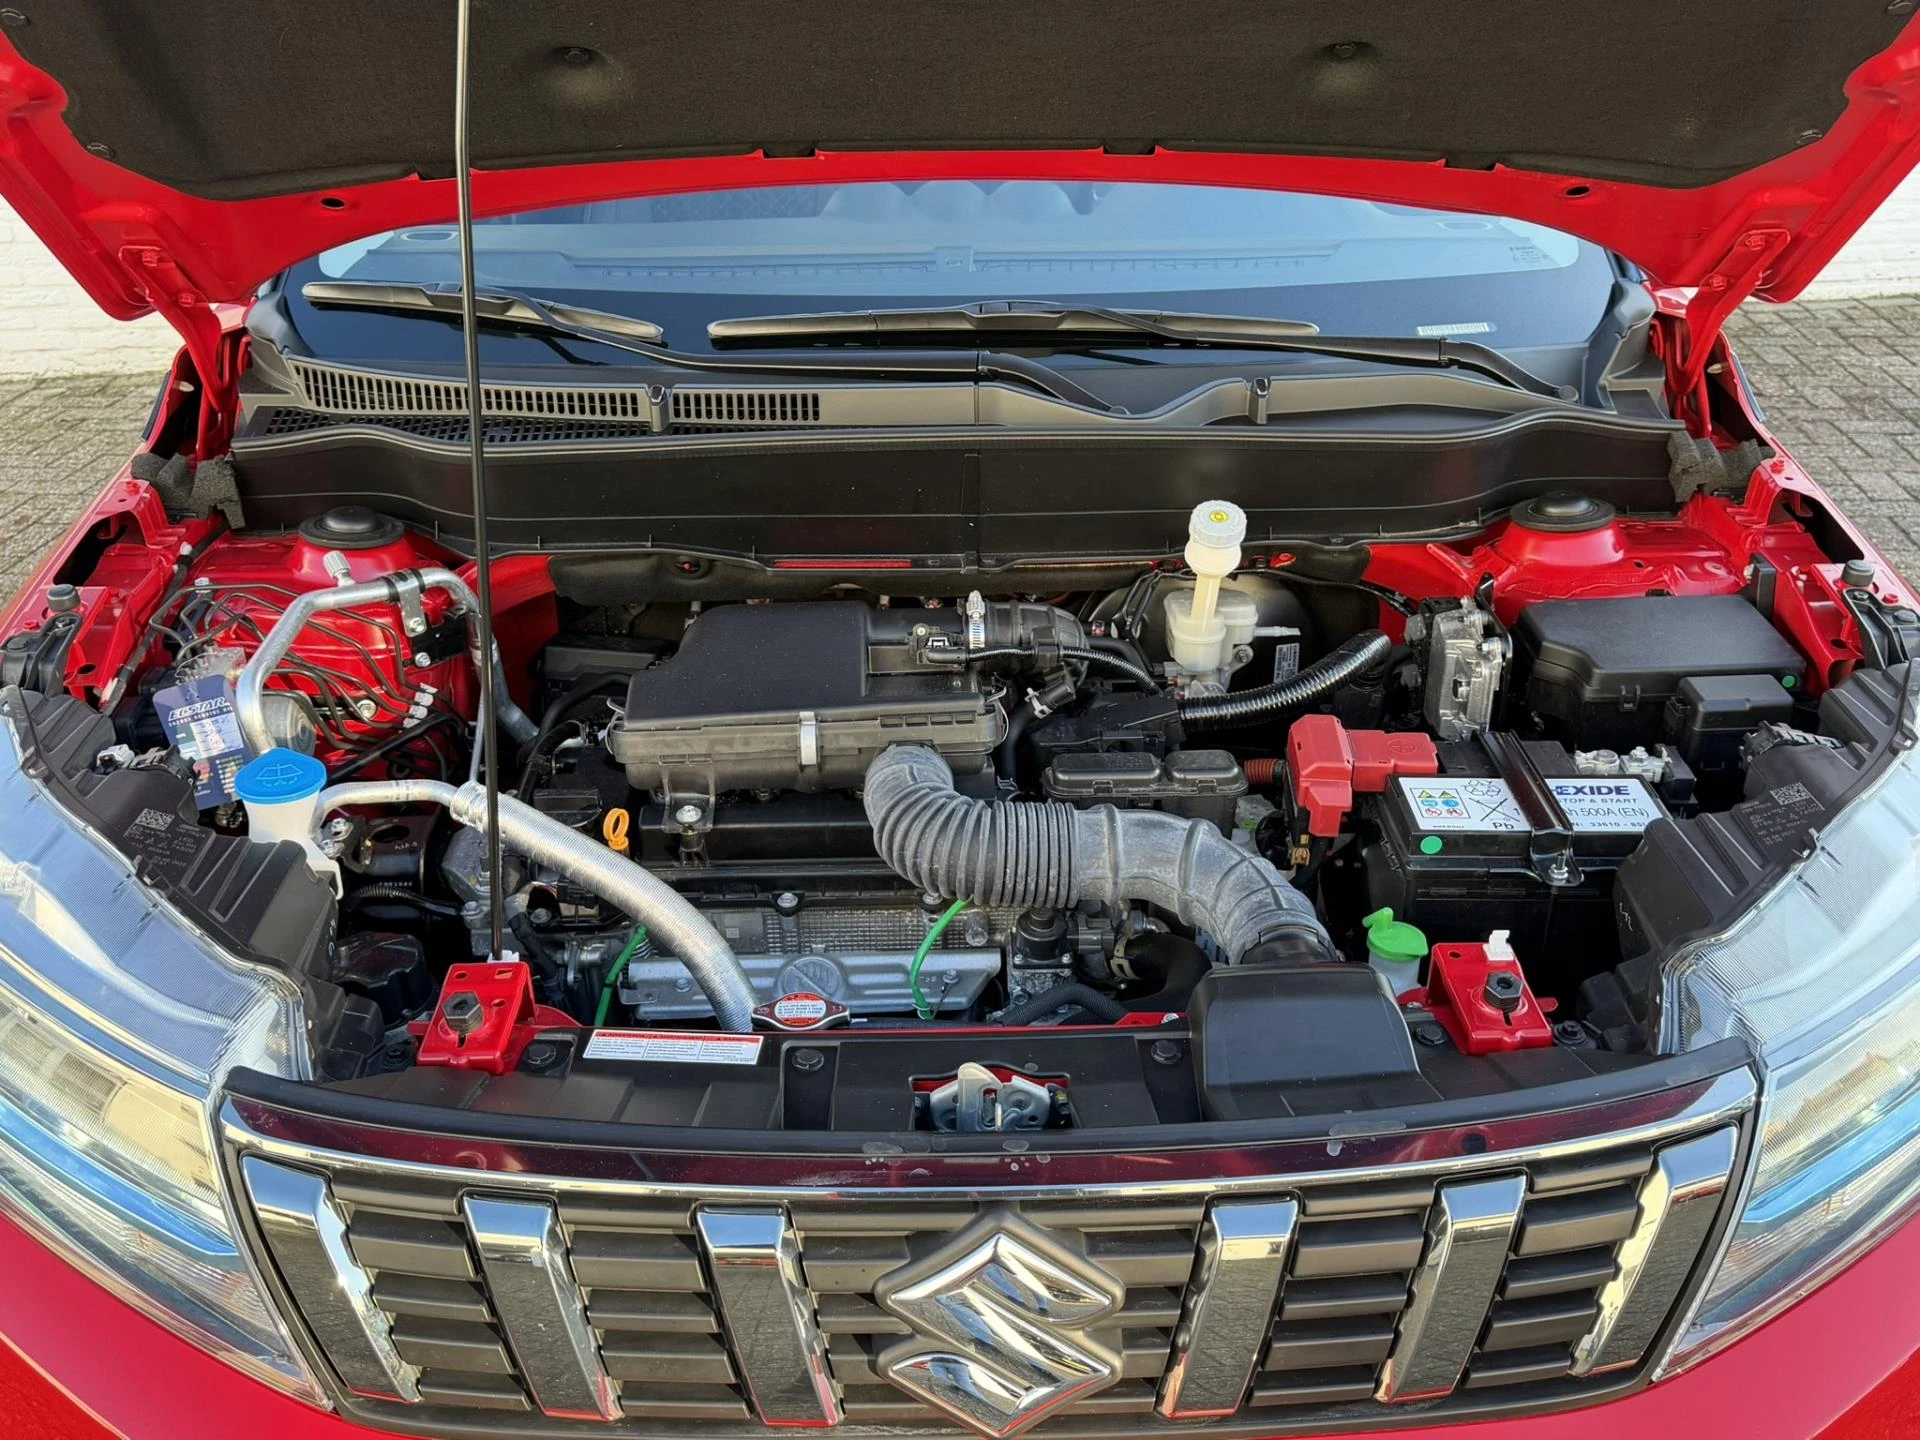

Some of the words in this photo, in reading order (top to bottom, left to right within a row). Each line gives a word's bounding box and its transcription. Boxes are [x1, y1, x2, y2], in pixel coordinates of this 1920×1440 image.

[168, 697, 231, 721] ECSTAR
[1555, 785, 1630, 796] EXIDE
[1581, 807, 1617, 817] 500A
[1618, 807, 1650, 819] (EN)
[1493, 821, 1515, 830] Pb
